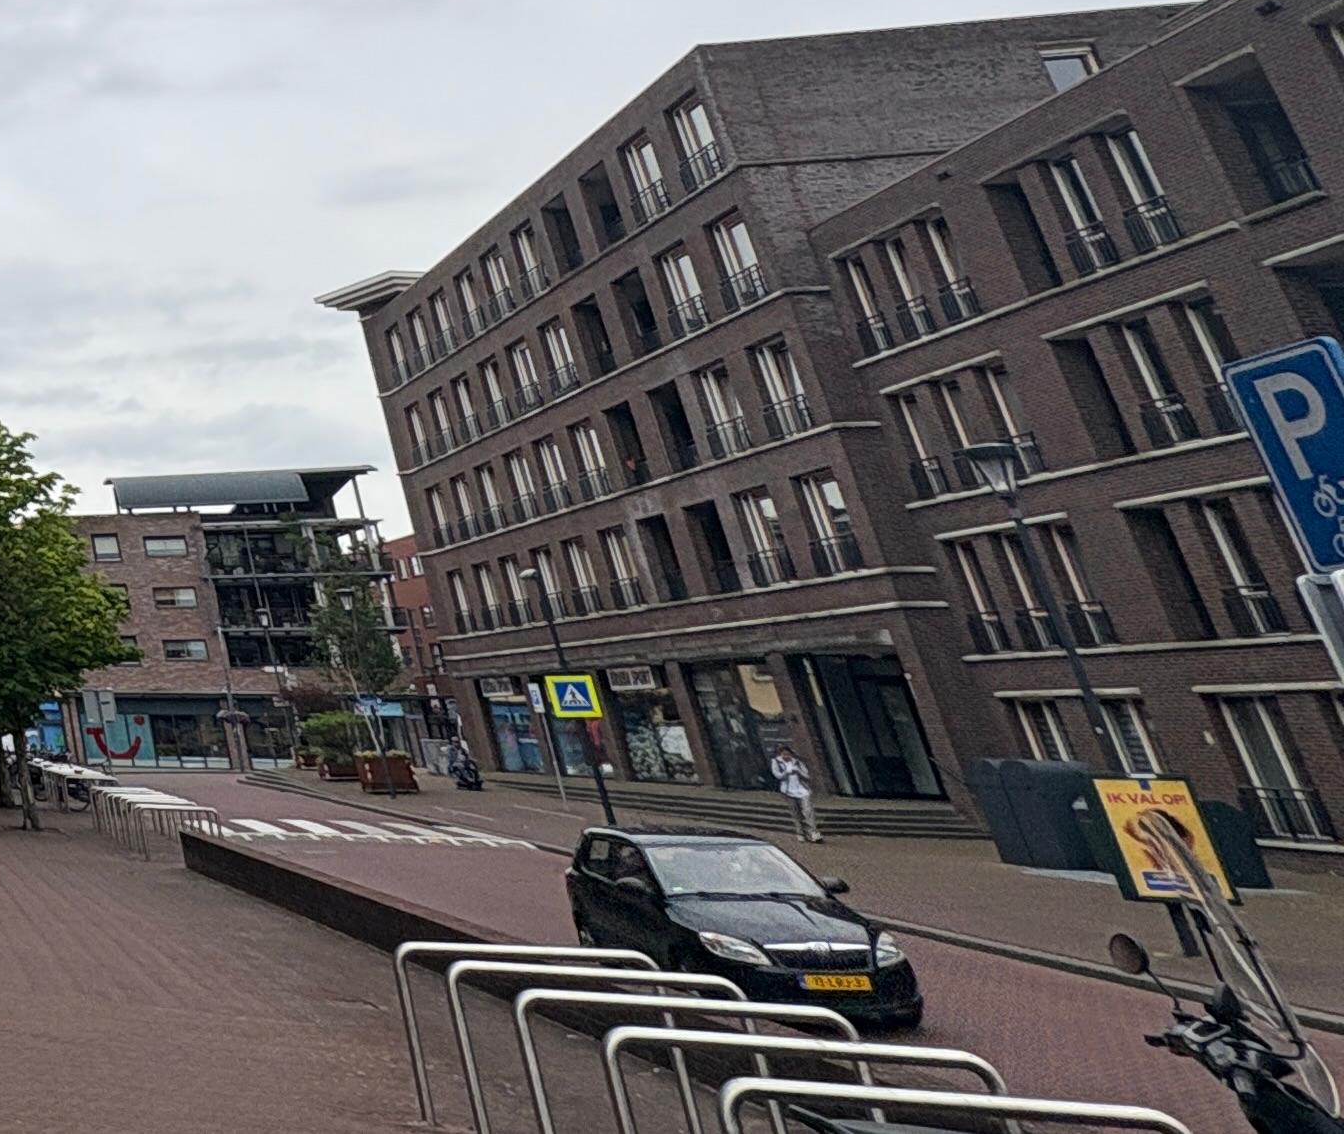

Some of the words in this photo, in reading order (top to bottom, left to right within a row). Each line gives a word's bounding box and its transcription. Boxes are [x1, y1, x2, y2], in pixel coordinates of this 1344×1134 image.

[1253, 372, 1327, 480] P
[1106, 792, 1127, 804] IK
[1126, 792, 1162, 805] VAL
